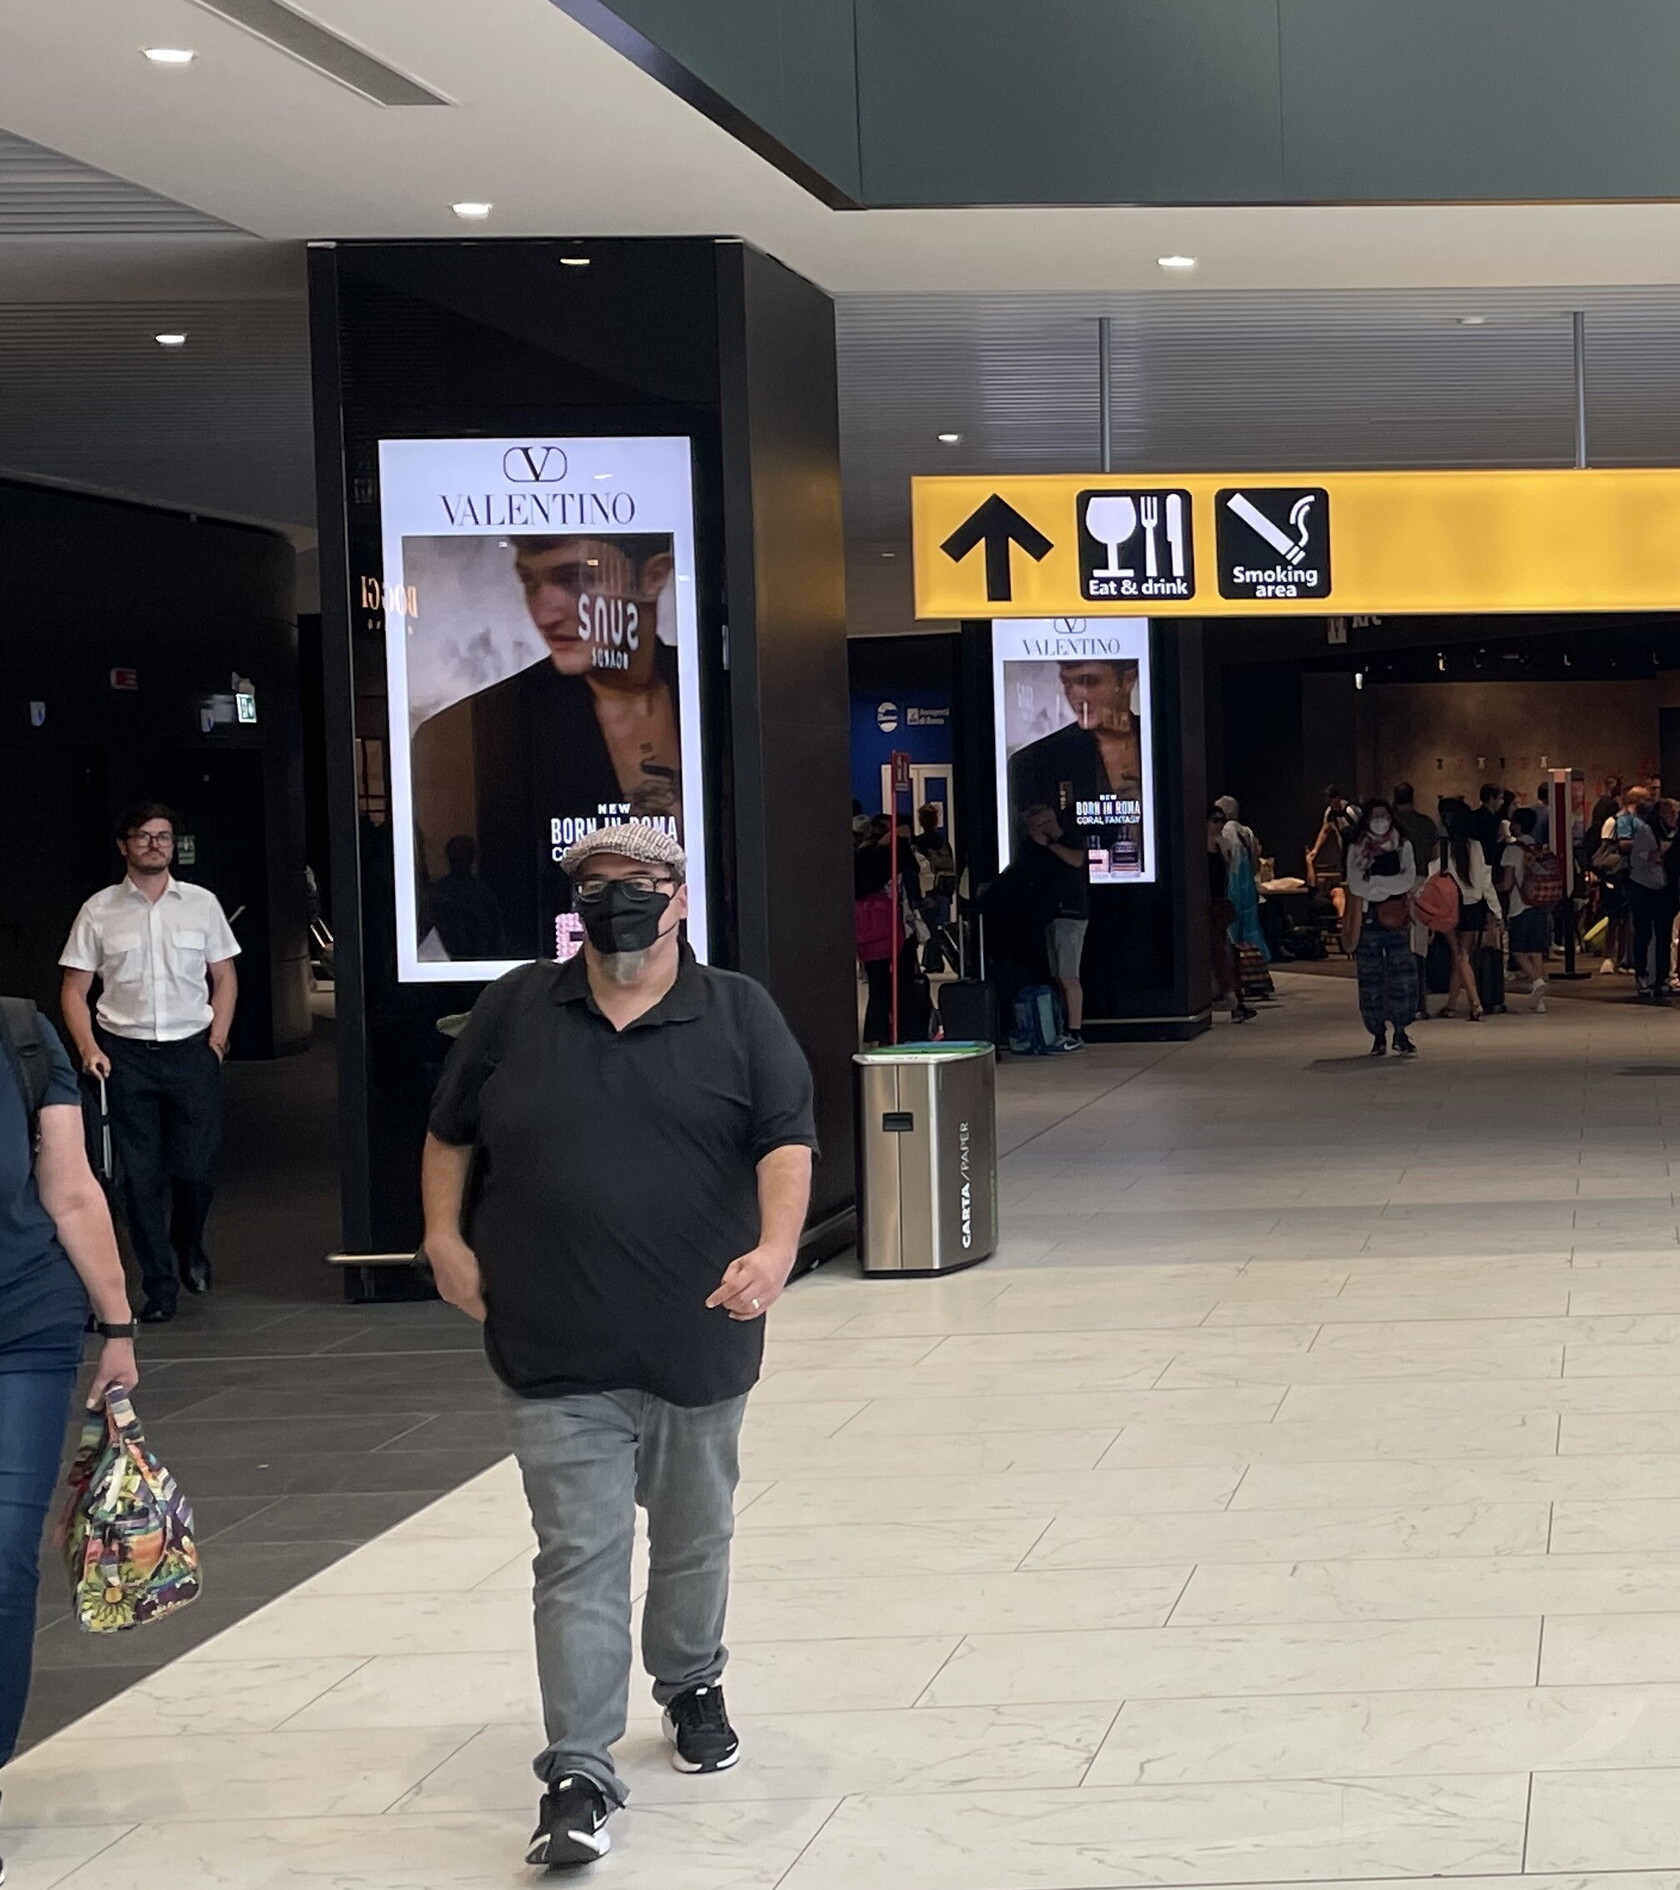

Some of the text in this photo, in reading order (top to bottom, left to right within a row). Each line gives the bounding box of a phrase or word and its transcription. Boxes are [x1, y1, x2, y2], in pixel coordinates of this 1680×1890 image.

[439, 492, 635, 526] VALENTINO
[1233, 566, 1317, 586] Smoking
[1089, 578, 1188, 595] Eat & drink
[1256, 584, 1297, 598] area
[1022, 638, 1120, 656] VALENTINO
[597, 803, 631, 814] NEW
